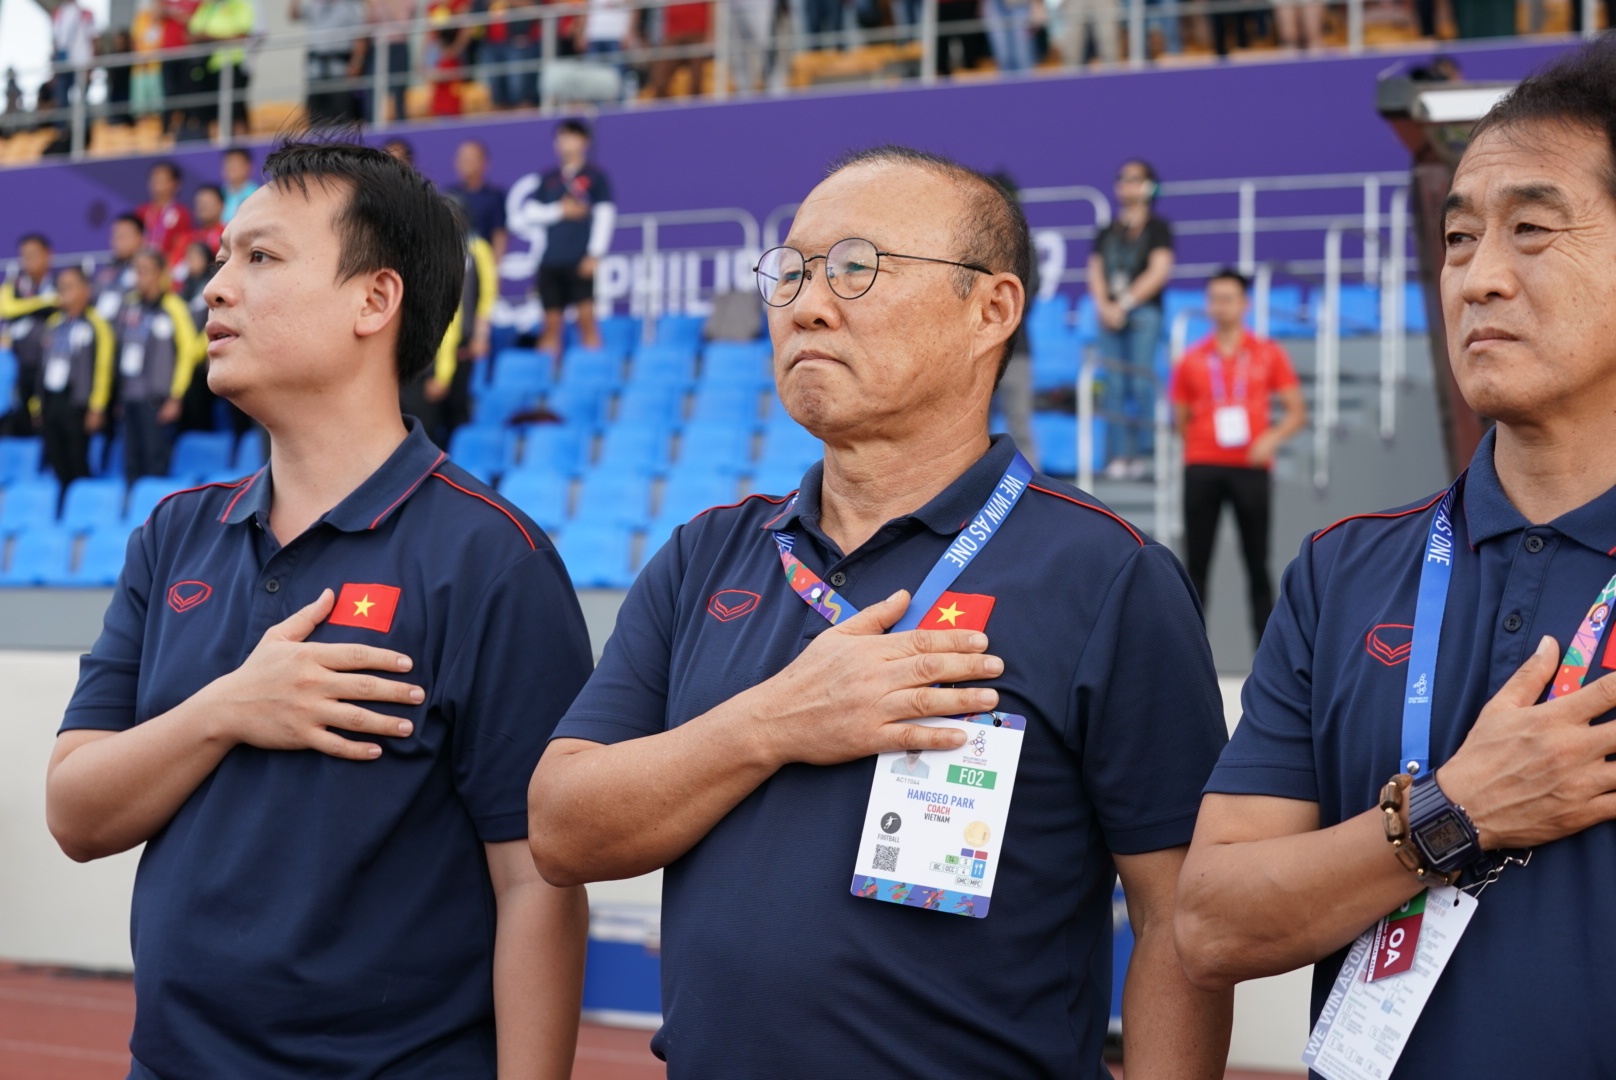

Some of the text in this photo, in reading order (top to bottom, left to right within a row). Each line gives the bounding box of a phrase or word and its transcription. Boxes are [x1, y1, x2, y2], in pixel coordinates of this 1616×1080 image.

[944, 474, 1024, 568] WE WIN AS ONE
[1435, 509, 1453, 536] AS
[1427, 533, 1452, 566] ONE
[906, 788, 975, 809] HANGSEO PARK
[927, 803, 951, 815] COACH
[924, 812, 951, 824] VIETNAM
[877, 833, 900, 844] FOOTBALL
[1383, 927, 1406, 969] OA
[1304, 1026, 1327, 1056] WE
[1319, 988, 1344, 1025] WIN
[1338, 964, 1355, 990] AS
[1348, 932, 1373, 965] ONE
